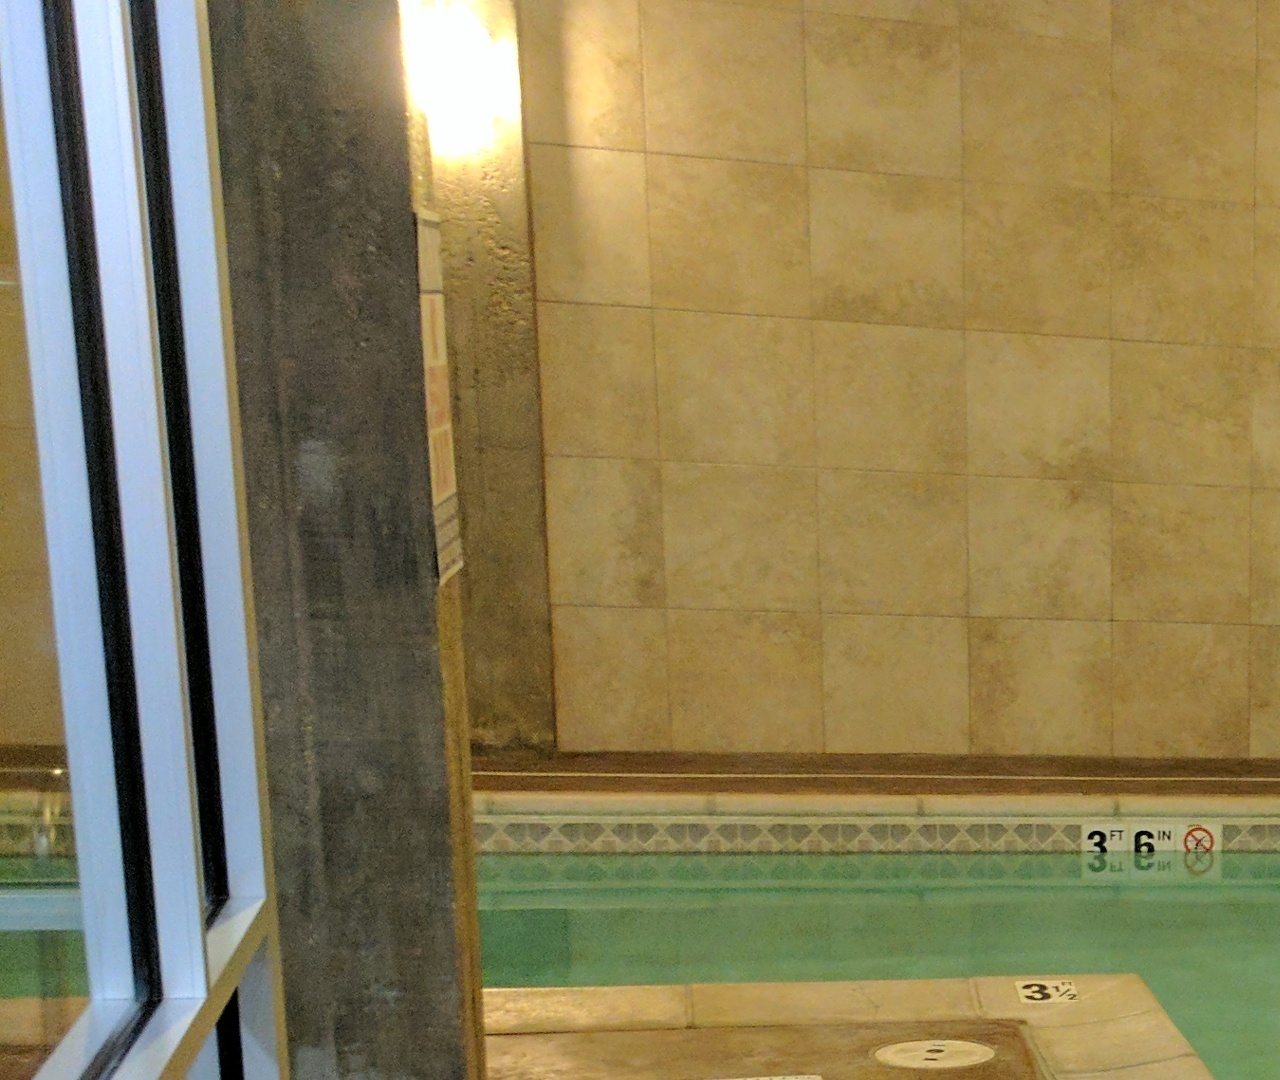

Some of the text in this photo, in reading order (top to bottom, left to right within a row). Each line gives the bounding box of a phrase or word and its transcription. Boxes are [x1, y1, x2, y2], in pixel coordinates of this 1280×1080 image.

[1087, 830, 1171, 853] 3 FT 6 IN
[1022, 984, 1052, 1001] 3
